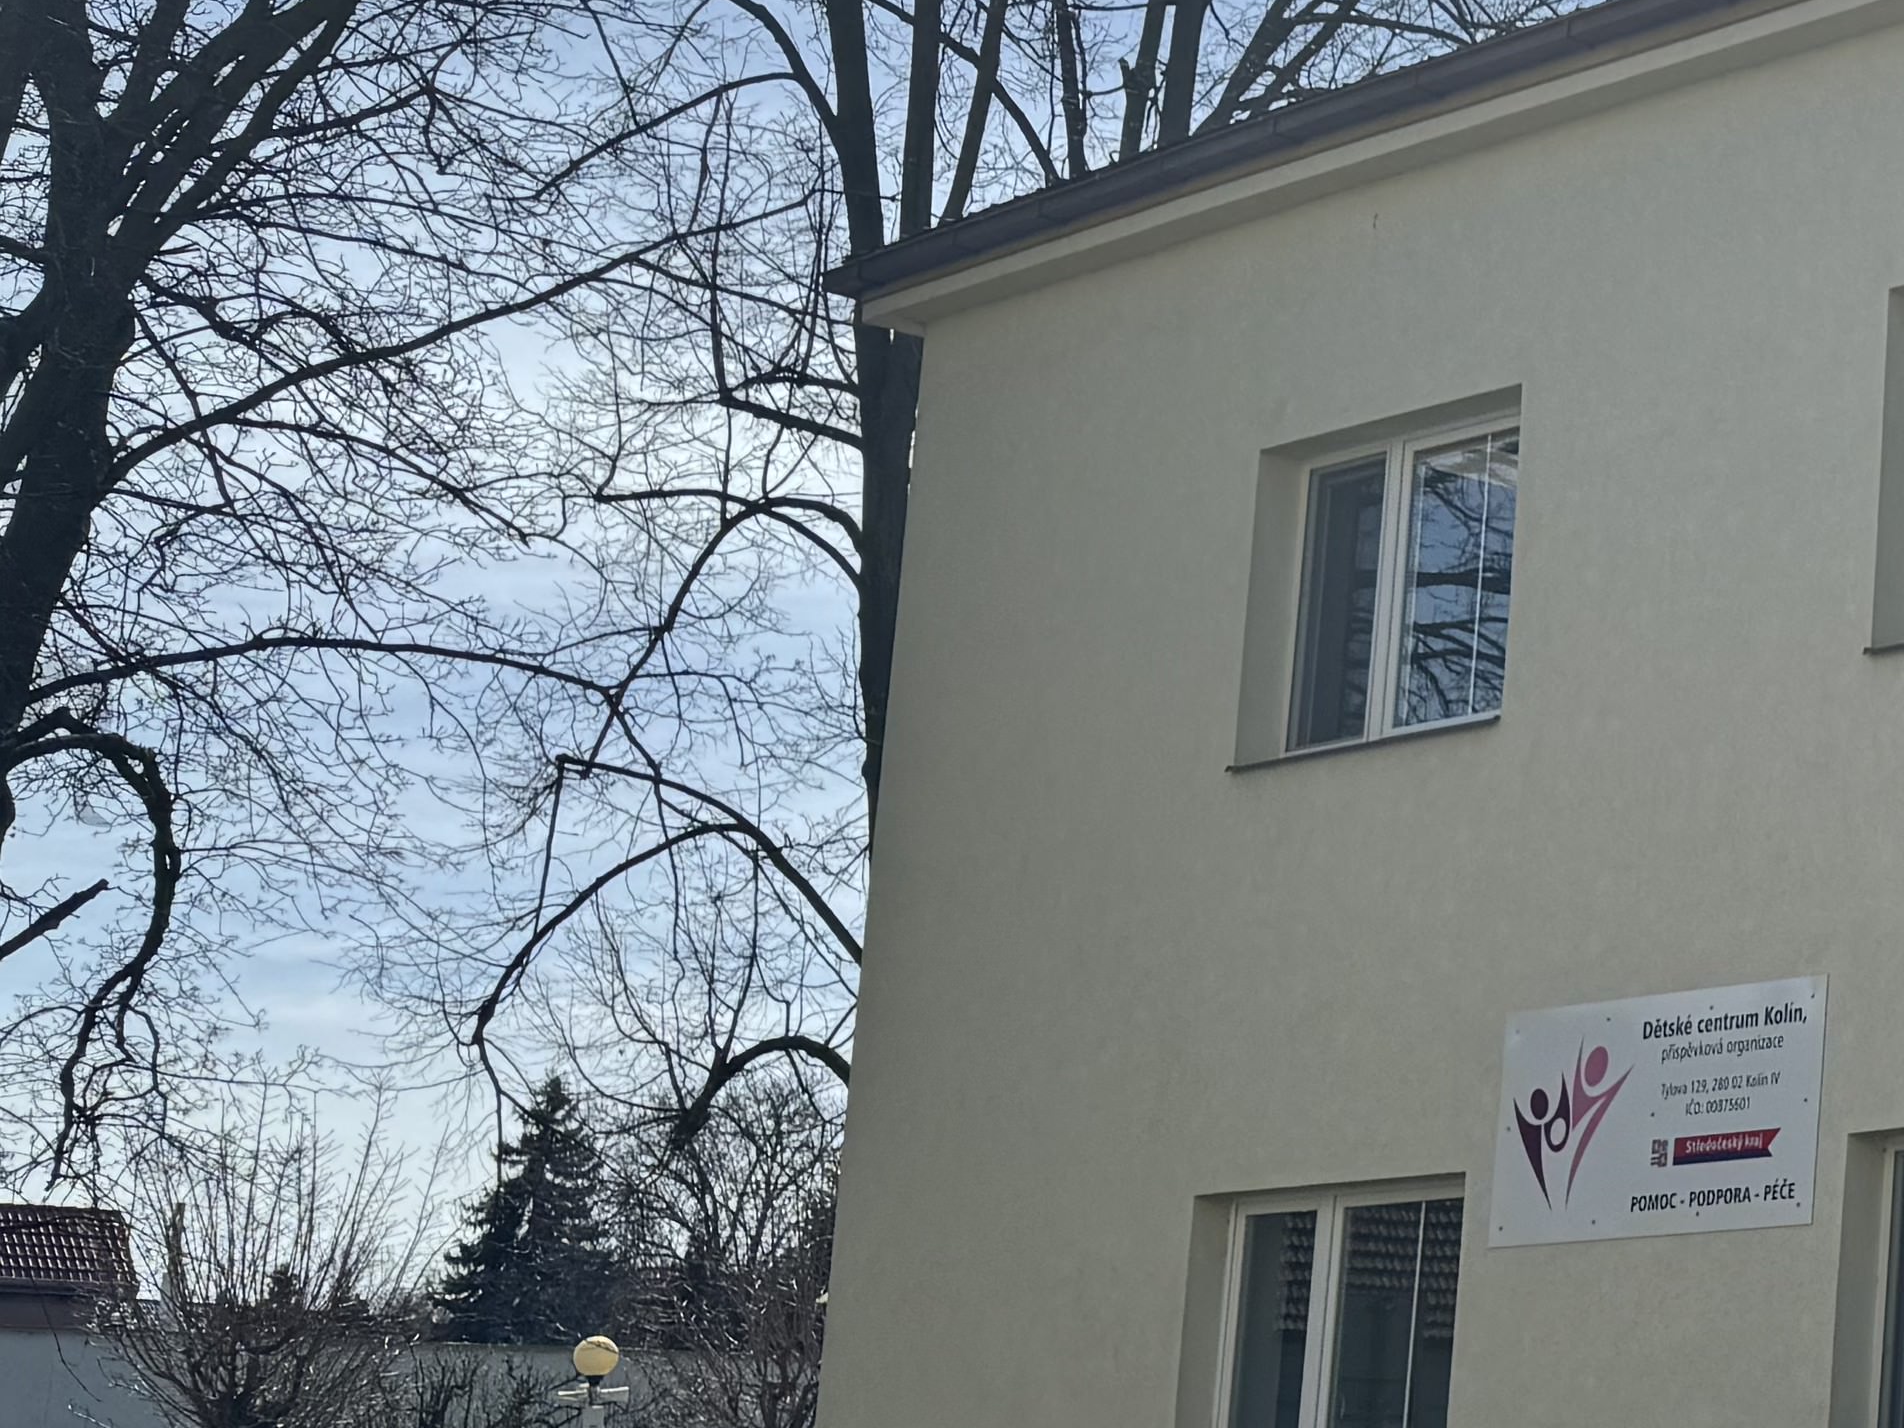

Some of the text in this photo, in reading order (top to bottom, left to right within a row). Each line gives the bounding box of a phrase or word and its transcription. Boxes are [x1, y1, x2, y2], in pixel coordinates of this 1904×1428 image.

[1643, 1002, 1807, 1040] Dětské centrum Kolín,
[1726, 1035, 1784, 1057] organizace
[1630, 1193, 1677, 1212] POMOC
[1689, 1186, 1751, 1208] PODPORA
[1763, 1178, 1795, 1201] PÉČE
